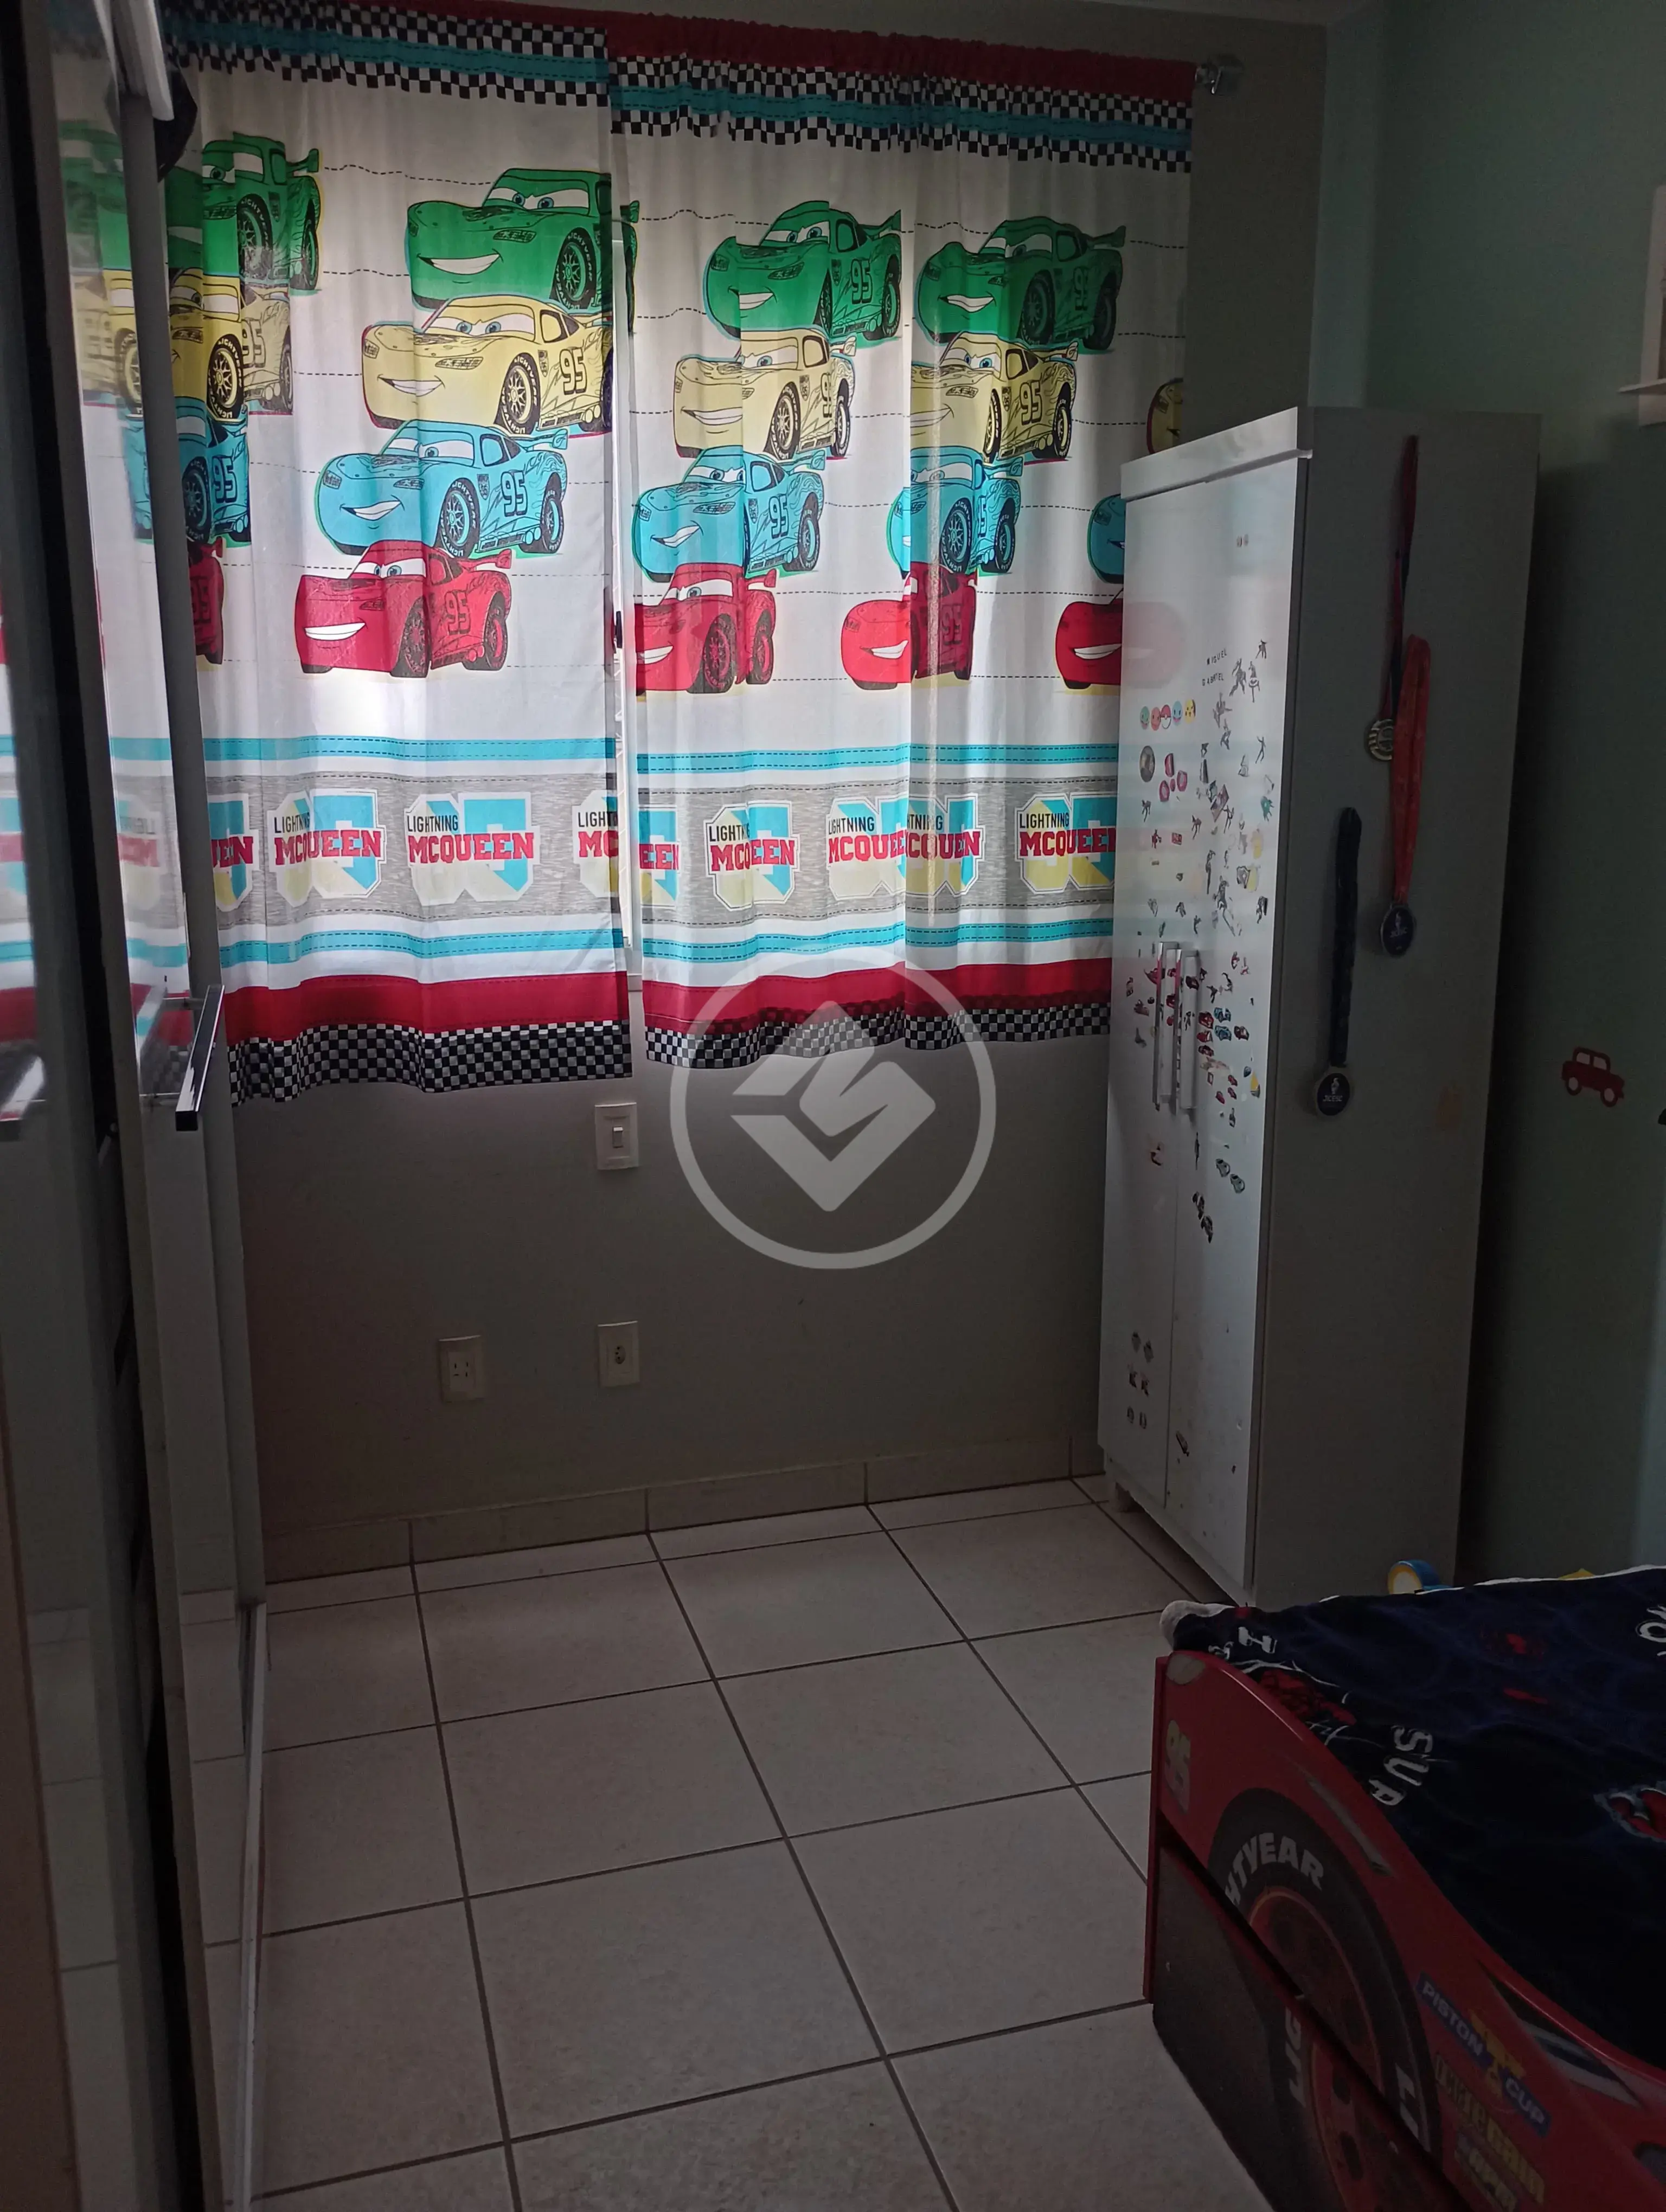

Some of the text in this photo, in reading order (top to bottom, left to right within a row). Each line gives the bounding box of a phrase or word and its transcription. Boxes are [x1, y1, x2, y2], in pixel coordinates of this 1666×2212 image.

[850, 257, 874, 304] 95
[559, 348, 588, 396] 95
[1020, 381, 1043, 426] 95
[213, 455, 238, 503] 95
[501, 471, 527, 516] 95
[768, 496, 789, 539] 95
[444, 589, 471, 635] 95
[1206, 648, 1228, 665] MIGUEL
[407, 814, 458, 833] LIGHTNING
[829, 816, 875, 835] LIGHTNING
[1020, 813, 1069, 828] LIGHTNING
[408, 832, 534, 864] MCQUEEN
[1422, 1980, 1545, 2124] PISTON CUP
